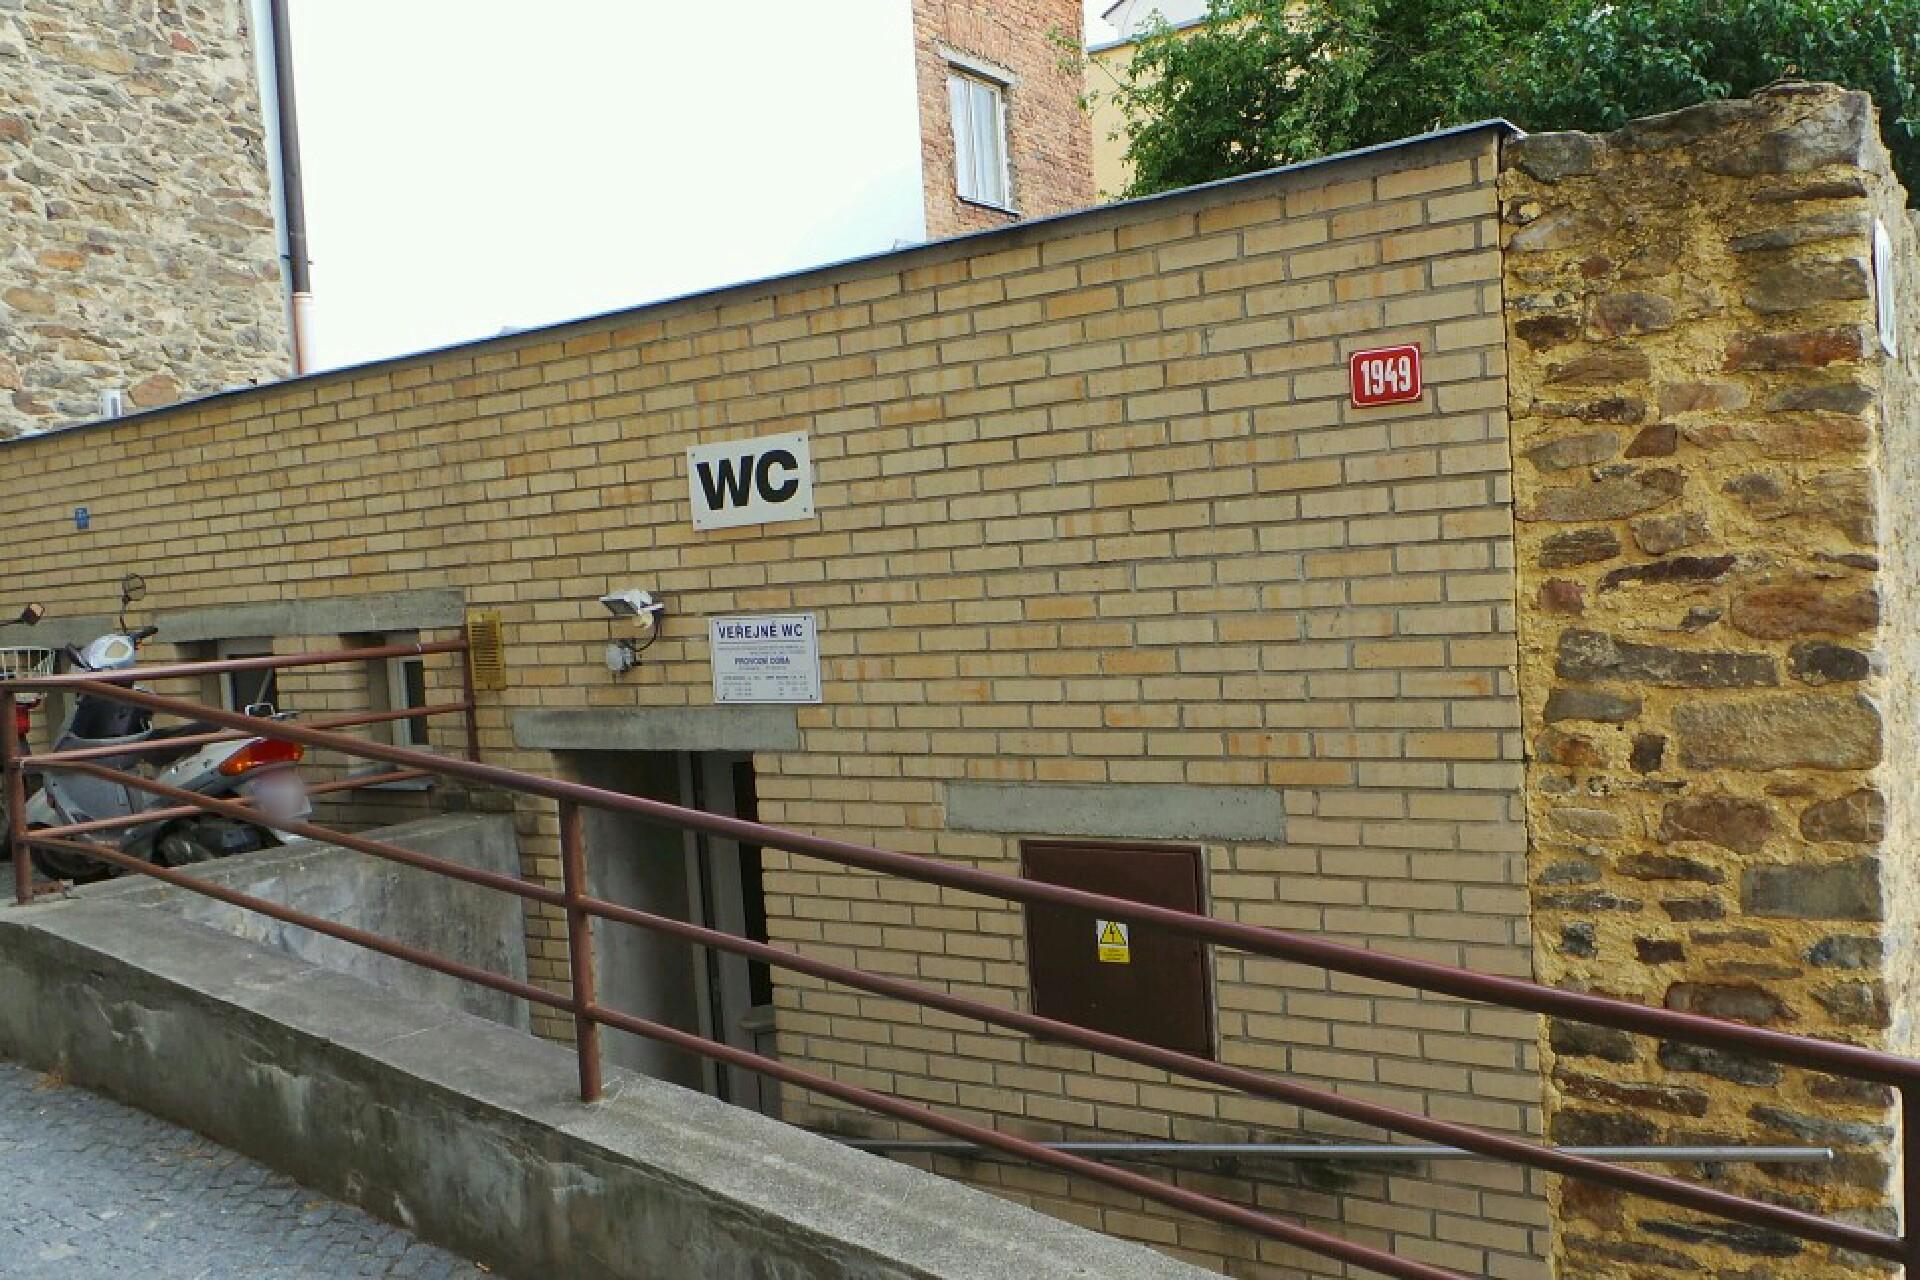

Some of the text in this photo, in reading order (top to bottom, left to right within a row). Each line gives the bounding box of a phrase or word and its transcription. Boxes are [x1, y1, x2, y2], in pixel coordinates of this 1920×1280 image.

[1361, 356, 1411, 395] 1949
[696, 449, 799, 511] WC
[719, 622, 803, 639] VEŘEJNÉ WC
